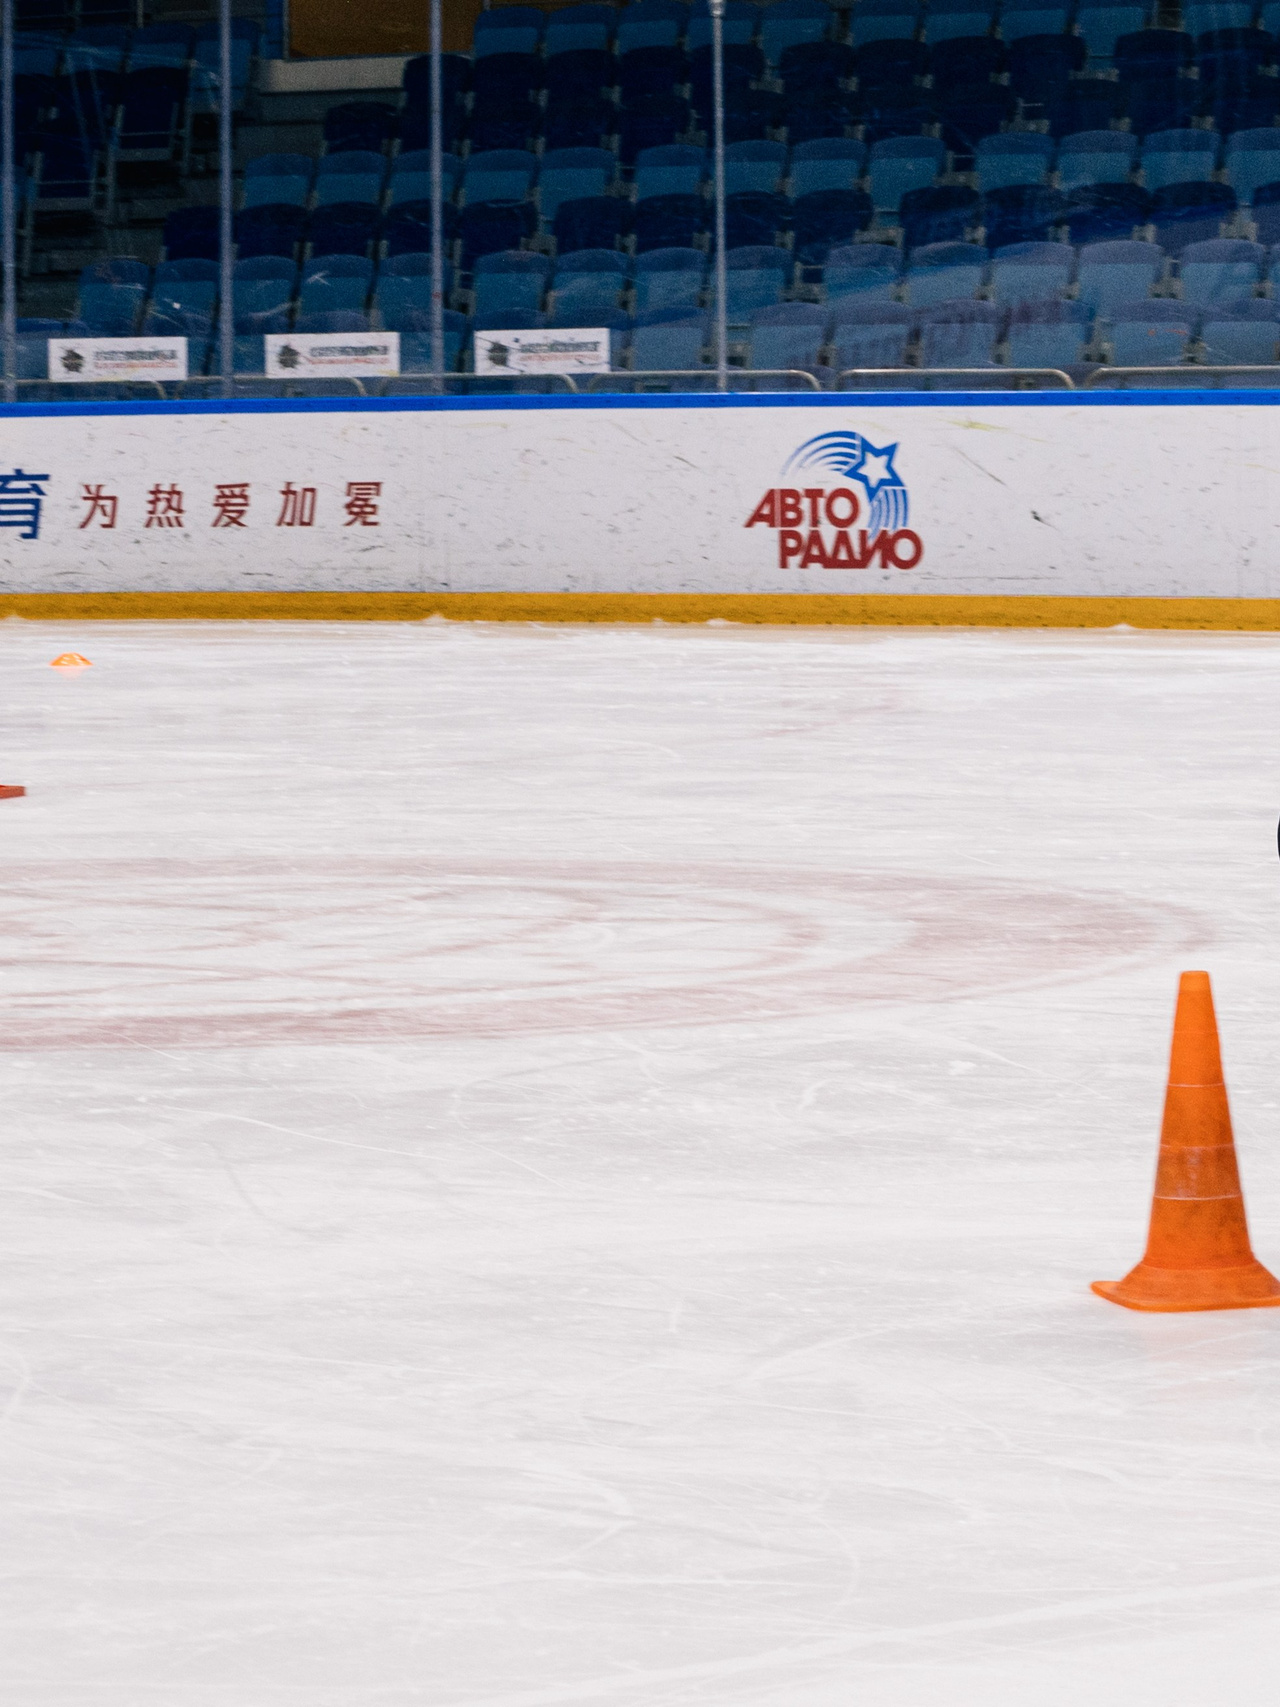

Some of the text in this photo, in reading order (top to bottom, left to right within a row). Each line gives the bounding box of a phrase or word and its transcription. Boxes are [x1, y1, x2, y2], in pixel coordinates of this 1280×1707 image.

[79, 481, 383, 529] 为热爱加冕
[743, 487, 860, 529] АВТО
[778, 528, 923, 570] РАДИО
